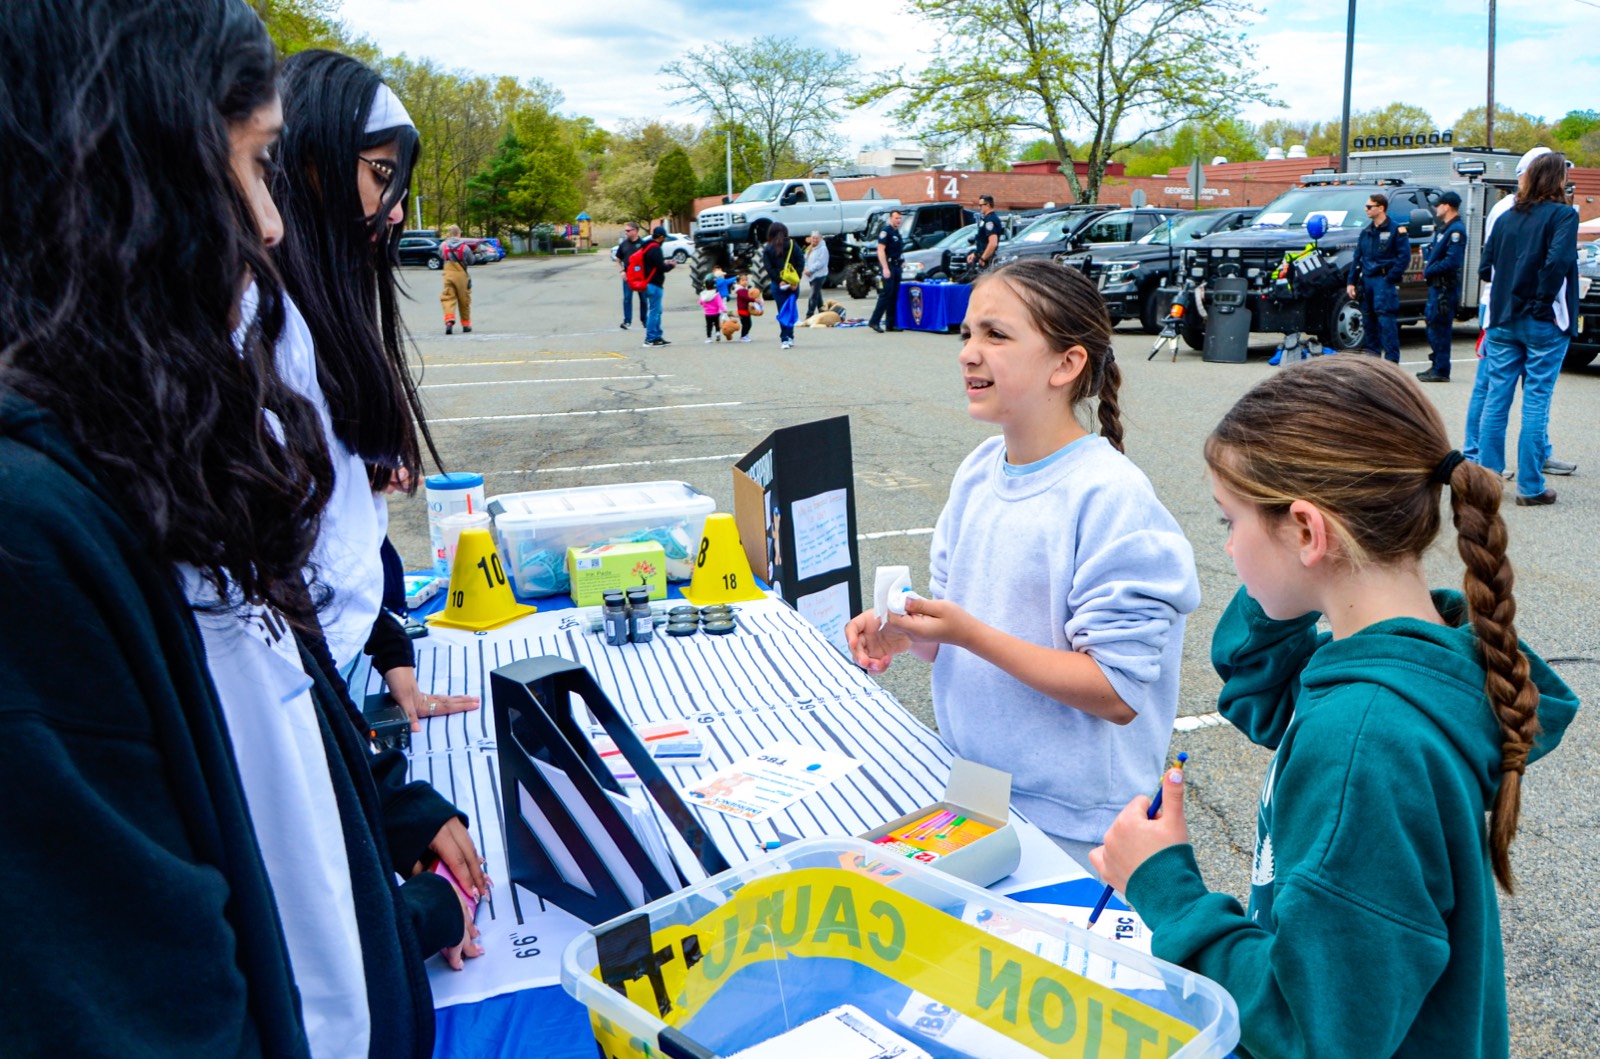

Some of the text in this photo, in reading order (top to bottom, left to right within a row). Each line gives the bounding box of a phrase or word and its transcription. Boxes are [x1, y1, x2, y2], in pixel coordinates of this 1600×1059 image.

[926, 177, 935, 199] 4
[944, 177, 960, 199] 4
[697, 536, 710, 568] 8
[477, 552, 505, 590] 10
[722, 573, 738, 590] 18
[451, 590, 464, 609] 10
[757, 754, 788, 766] TBC
[1115, 916, 1135, 942] TBC
